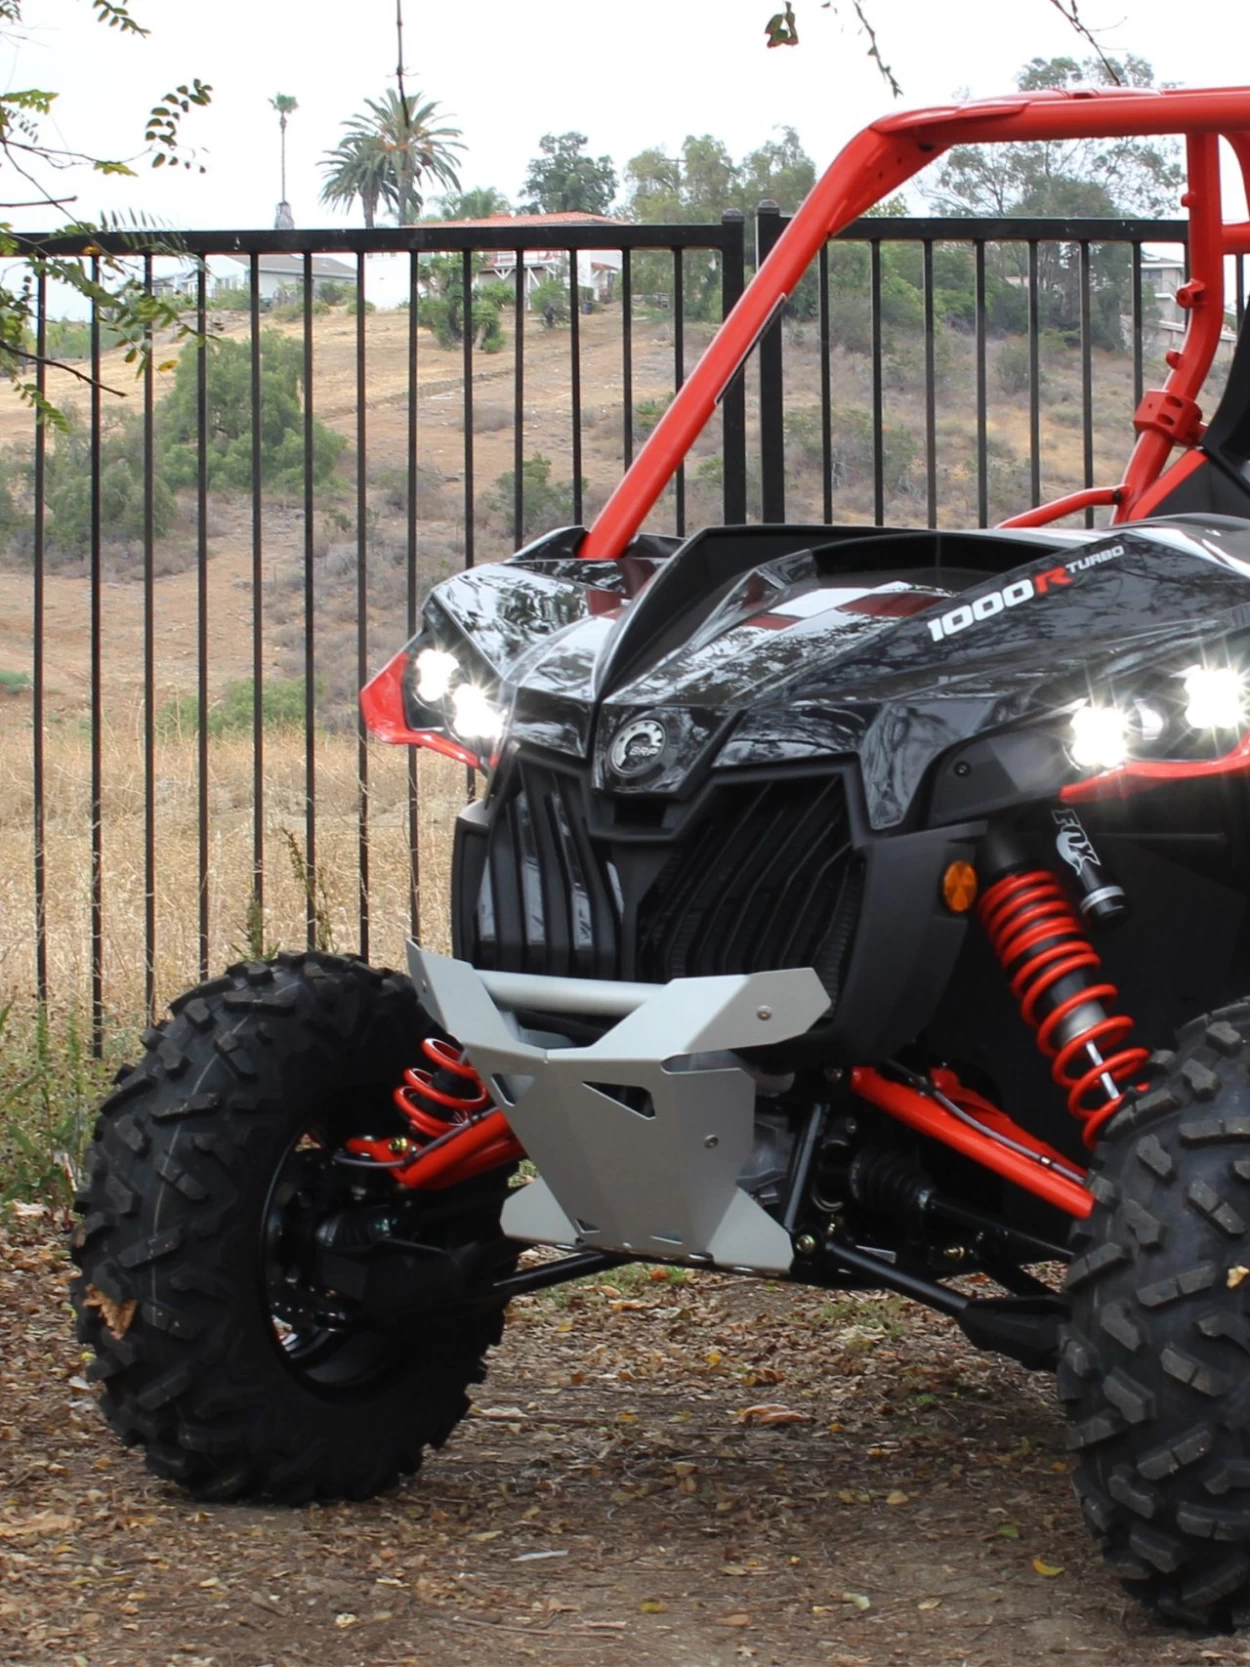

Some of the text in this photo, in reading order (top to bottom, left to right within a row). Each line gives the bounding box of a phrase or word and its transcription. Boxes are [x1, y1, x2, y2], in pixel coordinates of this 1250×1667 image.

[927, 545, 1125, 642] 1000R TURBO
[1051, 808, 1101, 875] FOX
